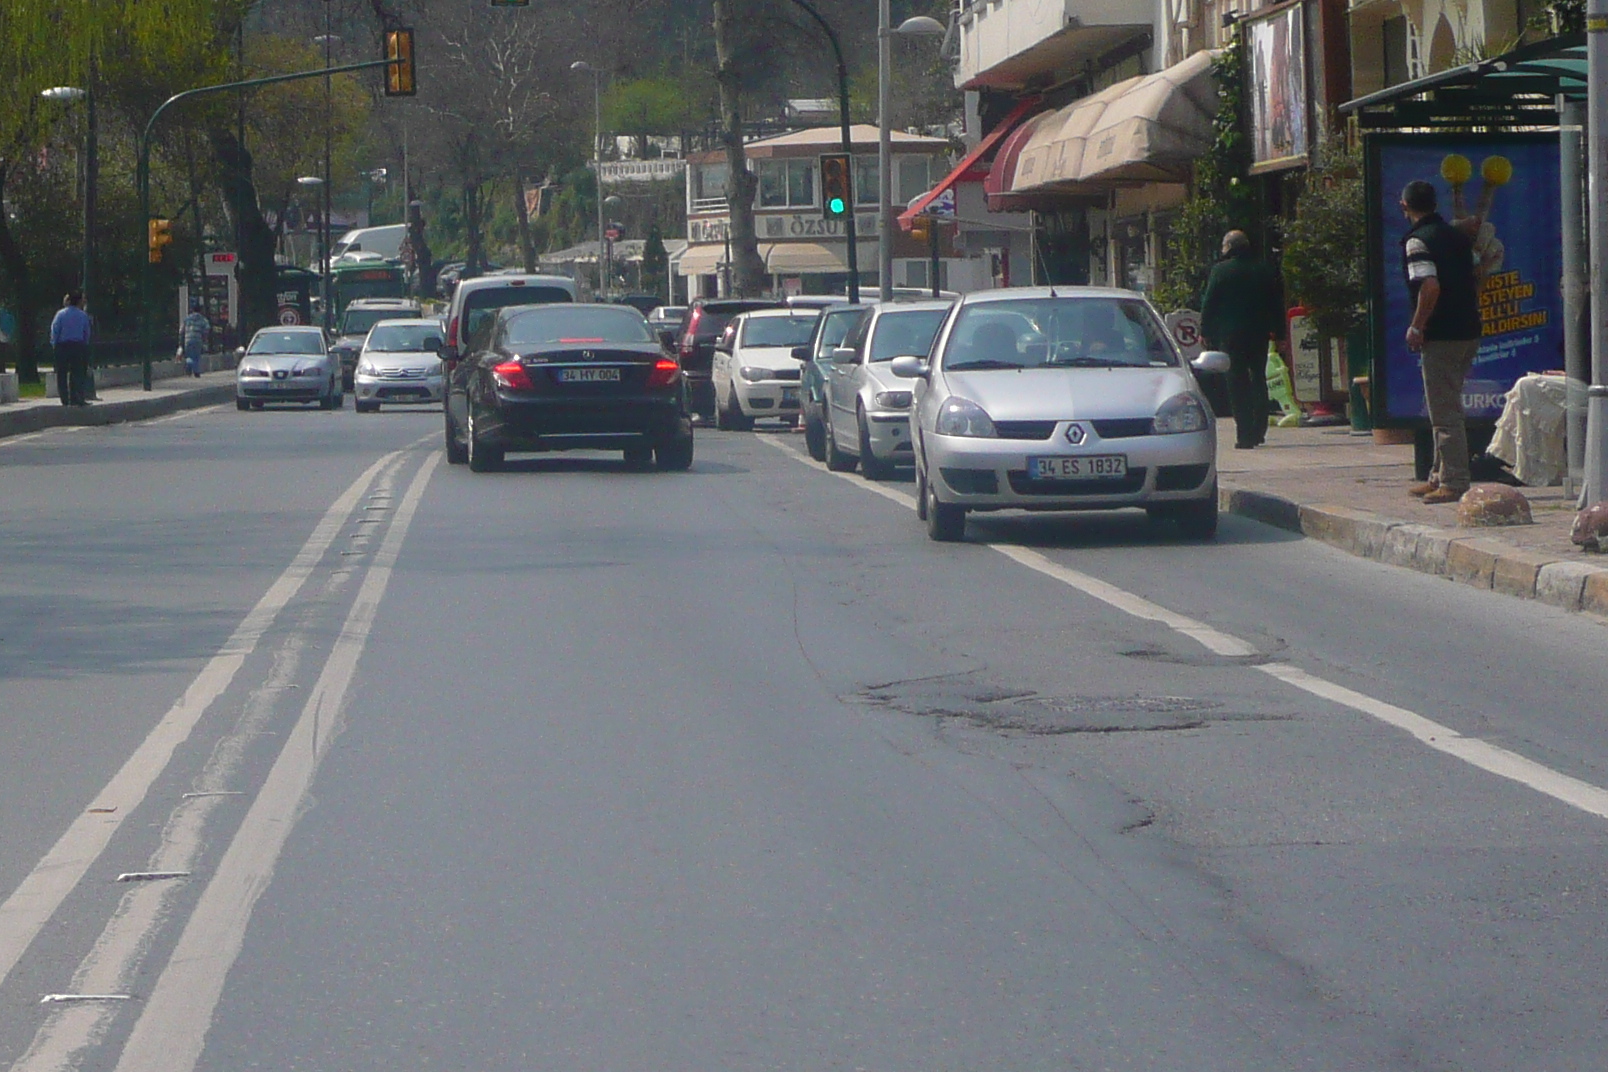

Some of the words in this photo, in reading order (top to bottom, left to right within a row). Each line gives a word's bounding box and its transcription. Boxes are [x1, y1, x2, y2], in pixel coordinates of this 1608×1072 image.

[562, 369, 576, 381] 34
[1038, 460, 1055, 475] 34
[1062, 459, 1080, 475] ES
[1088, 458, 1122, 474] 1832
